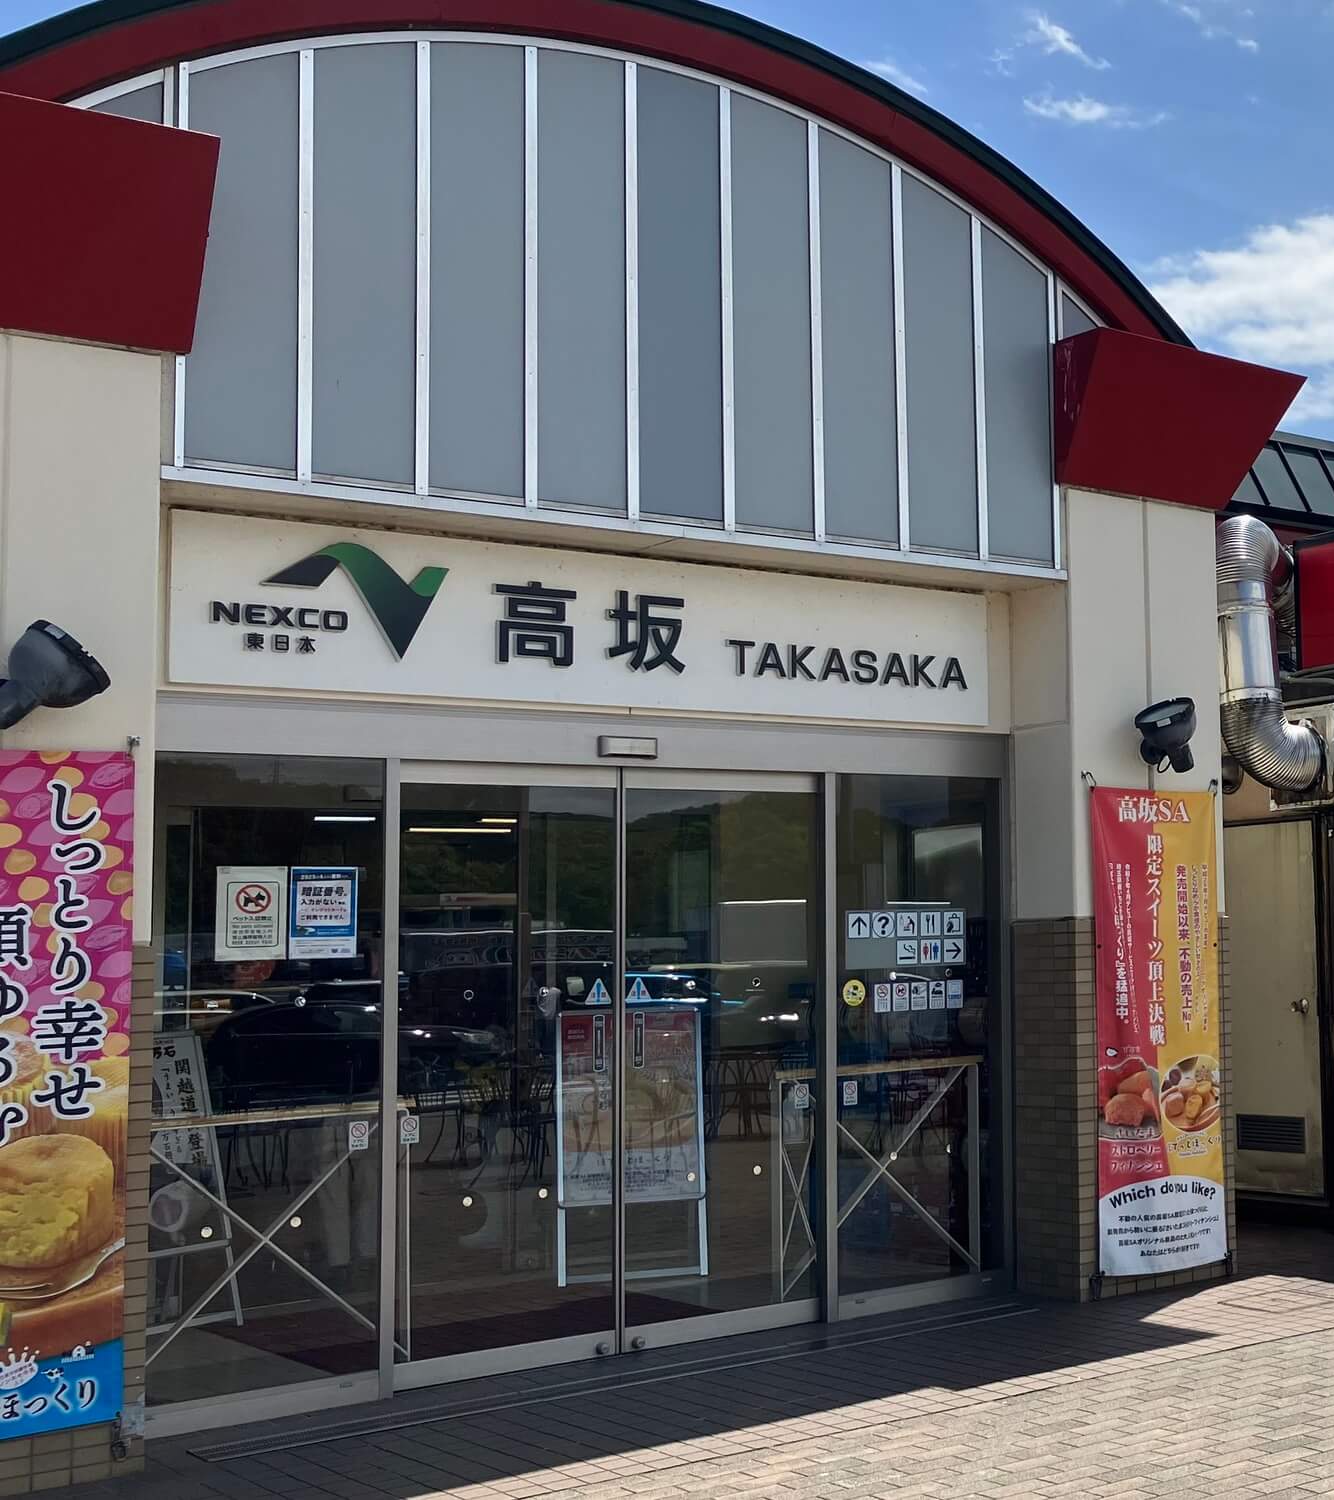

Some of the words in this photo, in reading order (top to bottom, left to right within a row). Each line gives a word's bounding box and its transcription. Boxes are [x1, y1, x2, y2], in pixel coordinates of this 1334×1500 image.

[209, 601, 348, 632] NEXCO
[492, 580, 686, 675] 高坂
[244, 633, 316, 653] 東日本
[726, 639, 969, 690] TAKASAKA
[1117, 797, 1190, 823] 高坂SA
[35, 782, 104, 1117] しっとり幸せ
[1145, 834, 1168, 1047] 限定スイーツ頂上決戦
[1109, 1185, 1156, 1209] Which
[1191, 1181, 1216, 1200] like?
